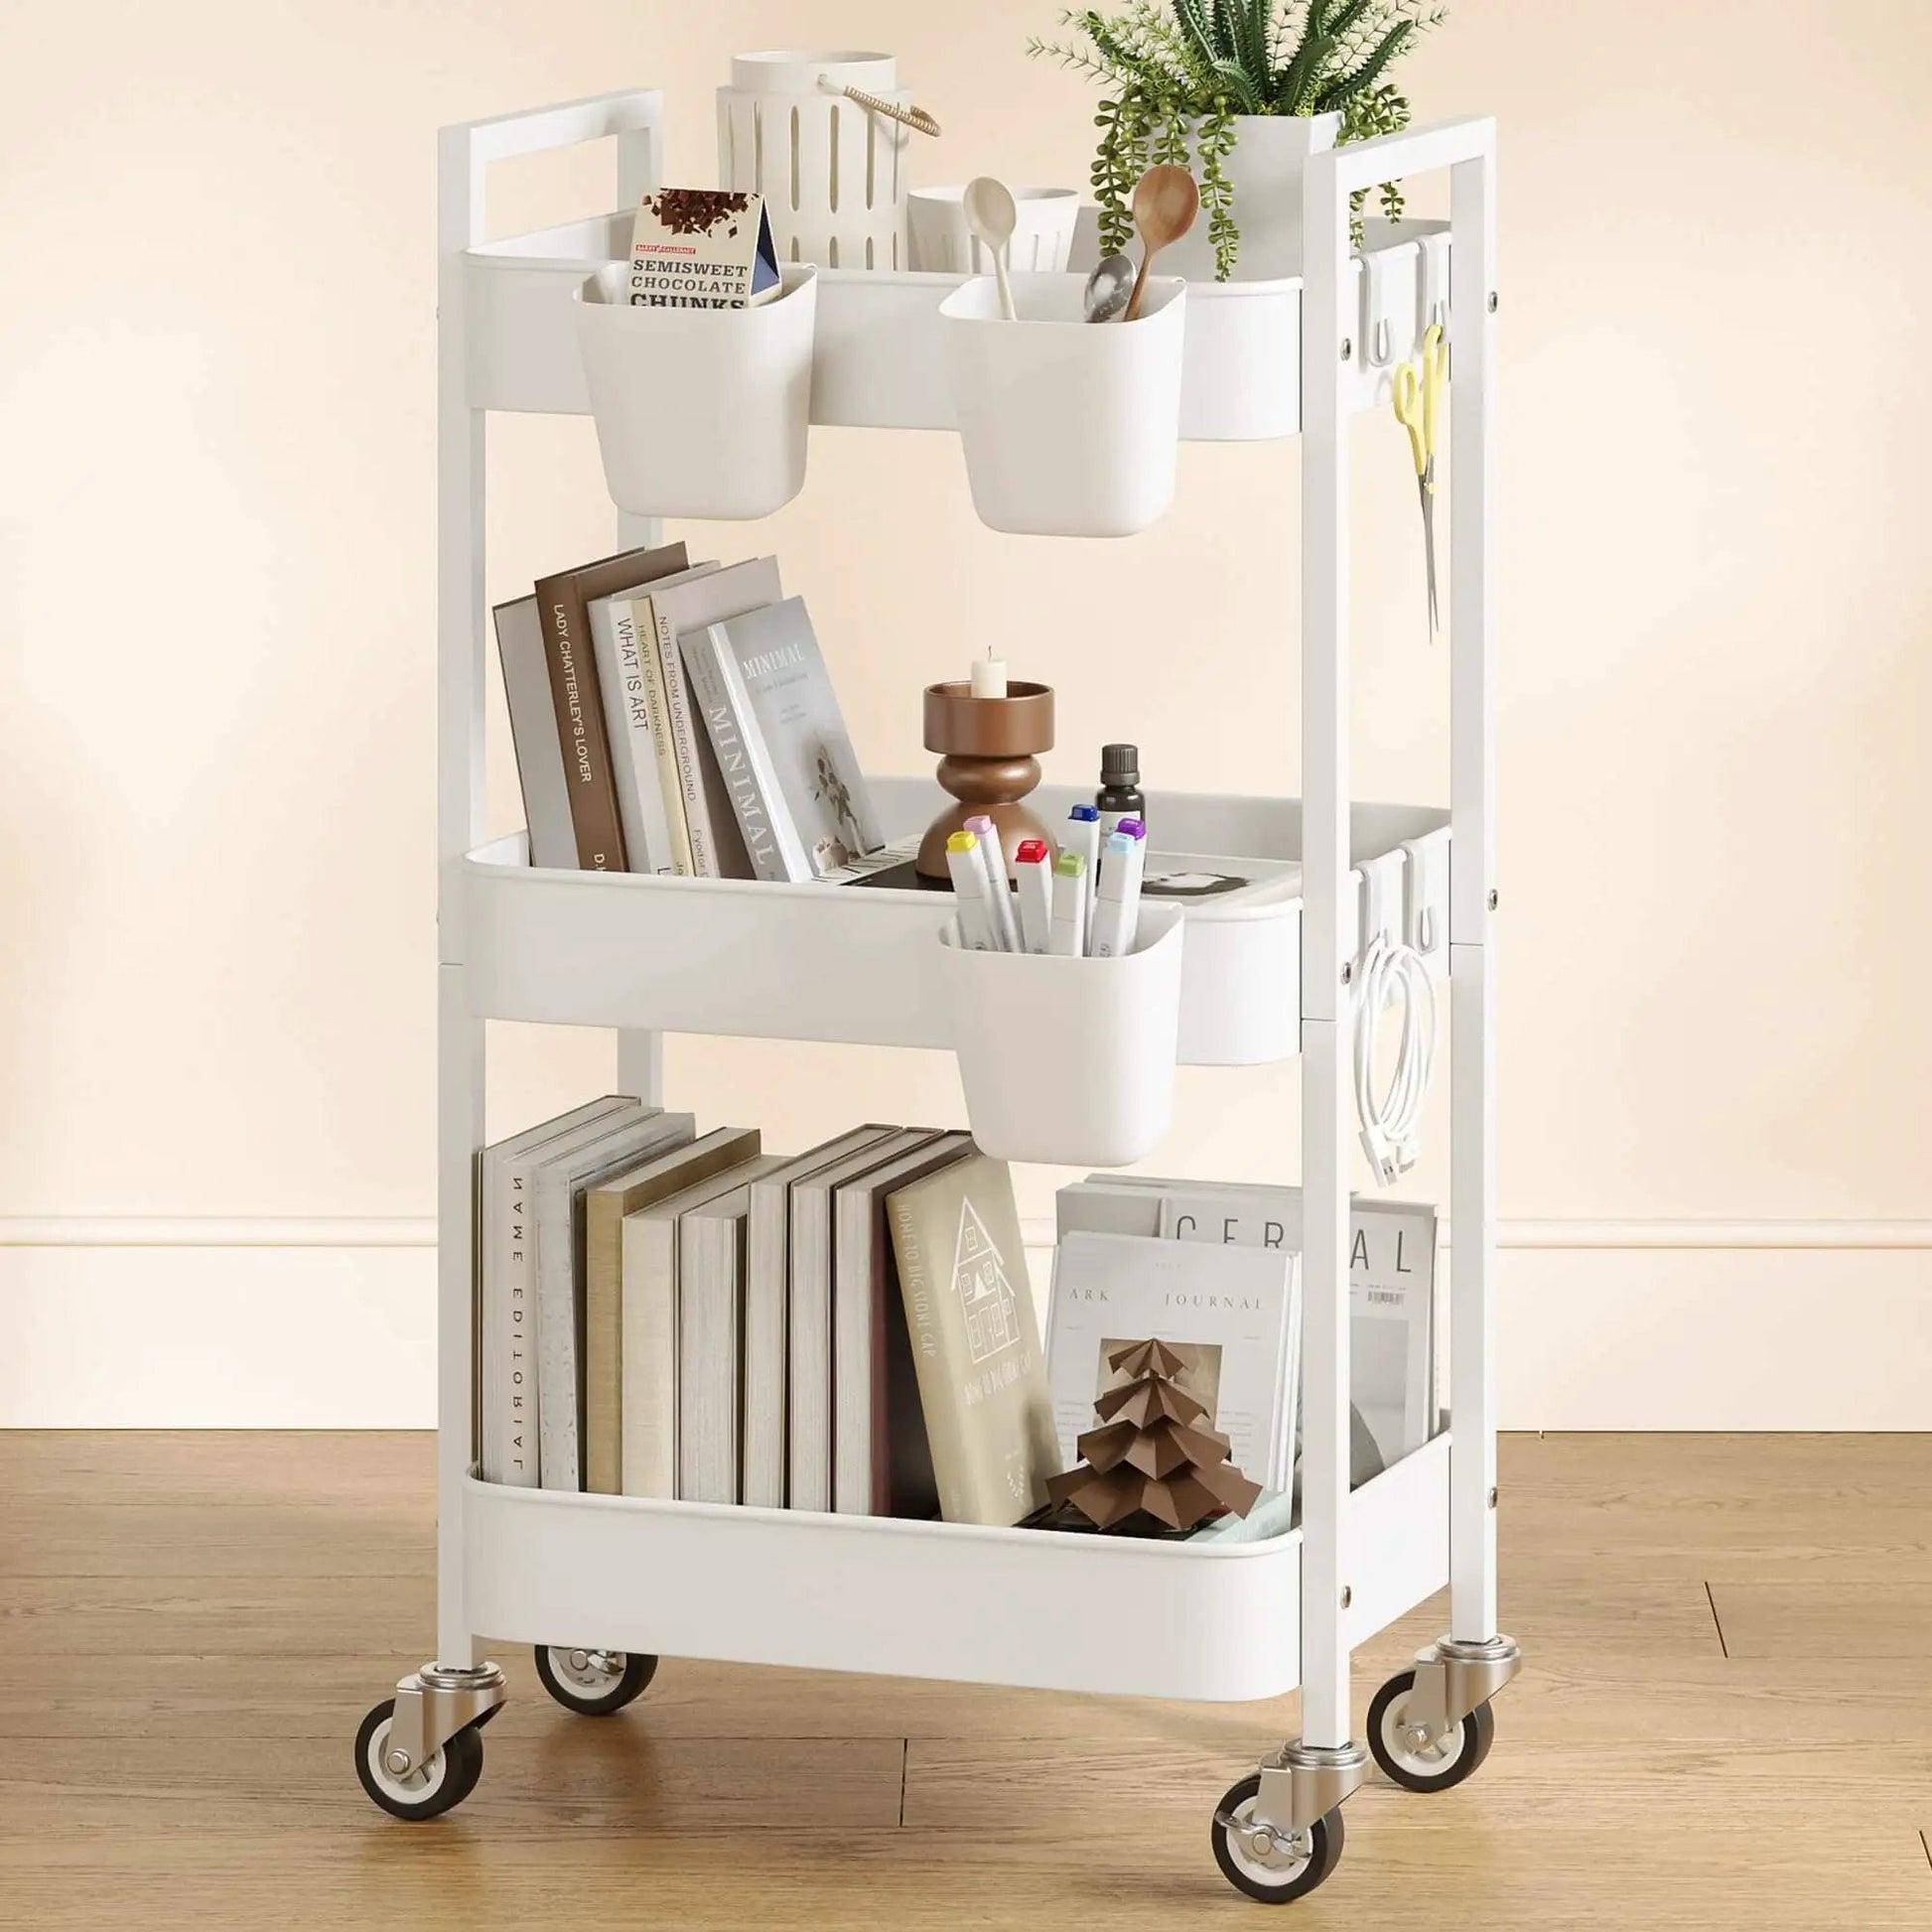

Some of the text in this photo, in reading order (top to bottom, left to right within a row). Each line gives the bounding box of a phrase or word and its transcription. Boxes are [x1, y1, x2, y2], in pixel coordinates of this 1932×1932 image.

[631, 276, 746, 295] CHOCOLATE
[633, 259, 748, 278] SEMISWEET
[554, 604, 592, 782] LADY CHATTERLEY'S LOVER
[618, 618, 648, 731] WHAT IS ART
[637, 624, 651, 665] HEART
[648, 690, 666, 757] DARKNESS
[659, 617, 696, 801] NOTES FROM UNDERGROUND
[744, 643, 806, 680] MINIMAL
[710, 705, 774, 866] MINIMAL
[1069, 1289, 1264, 1311] ARK JOURNAL
